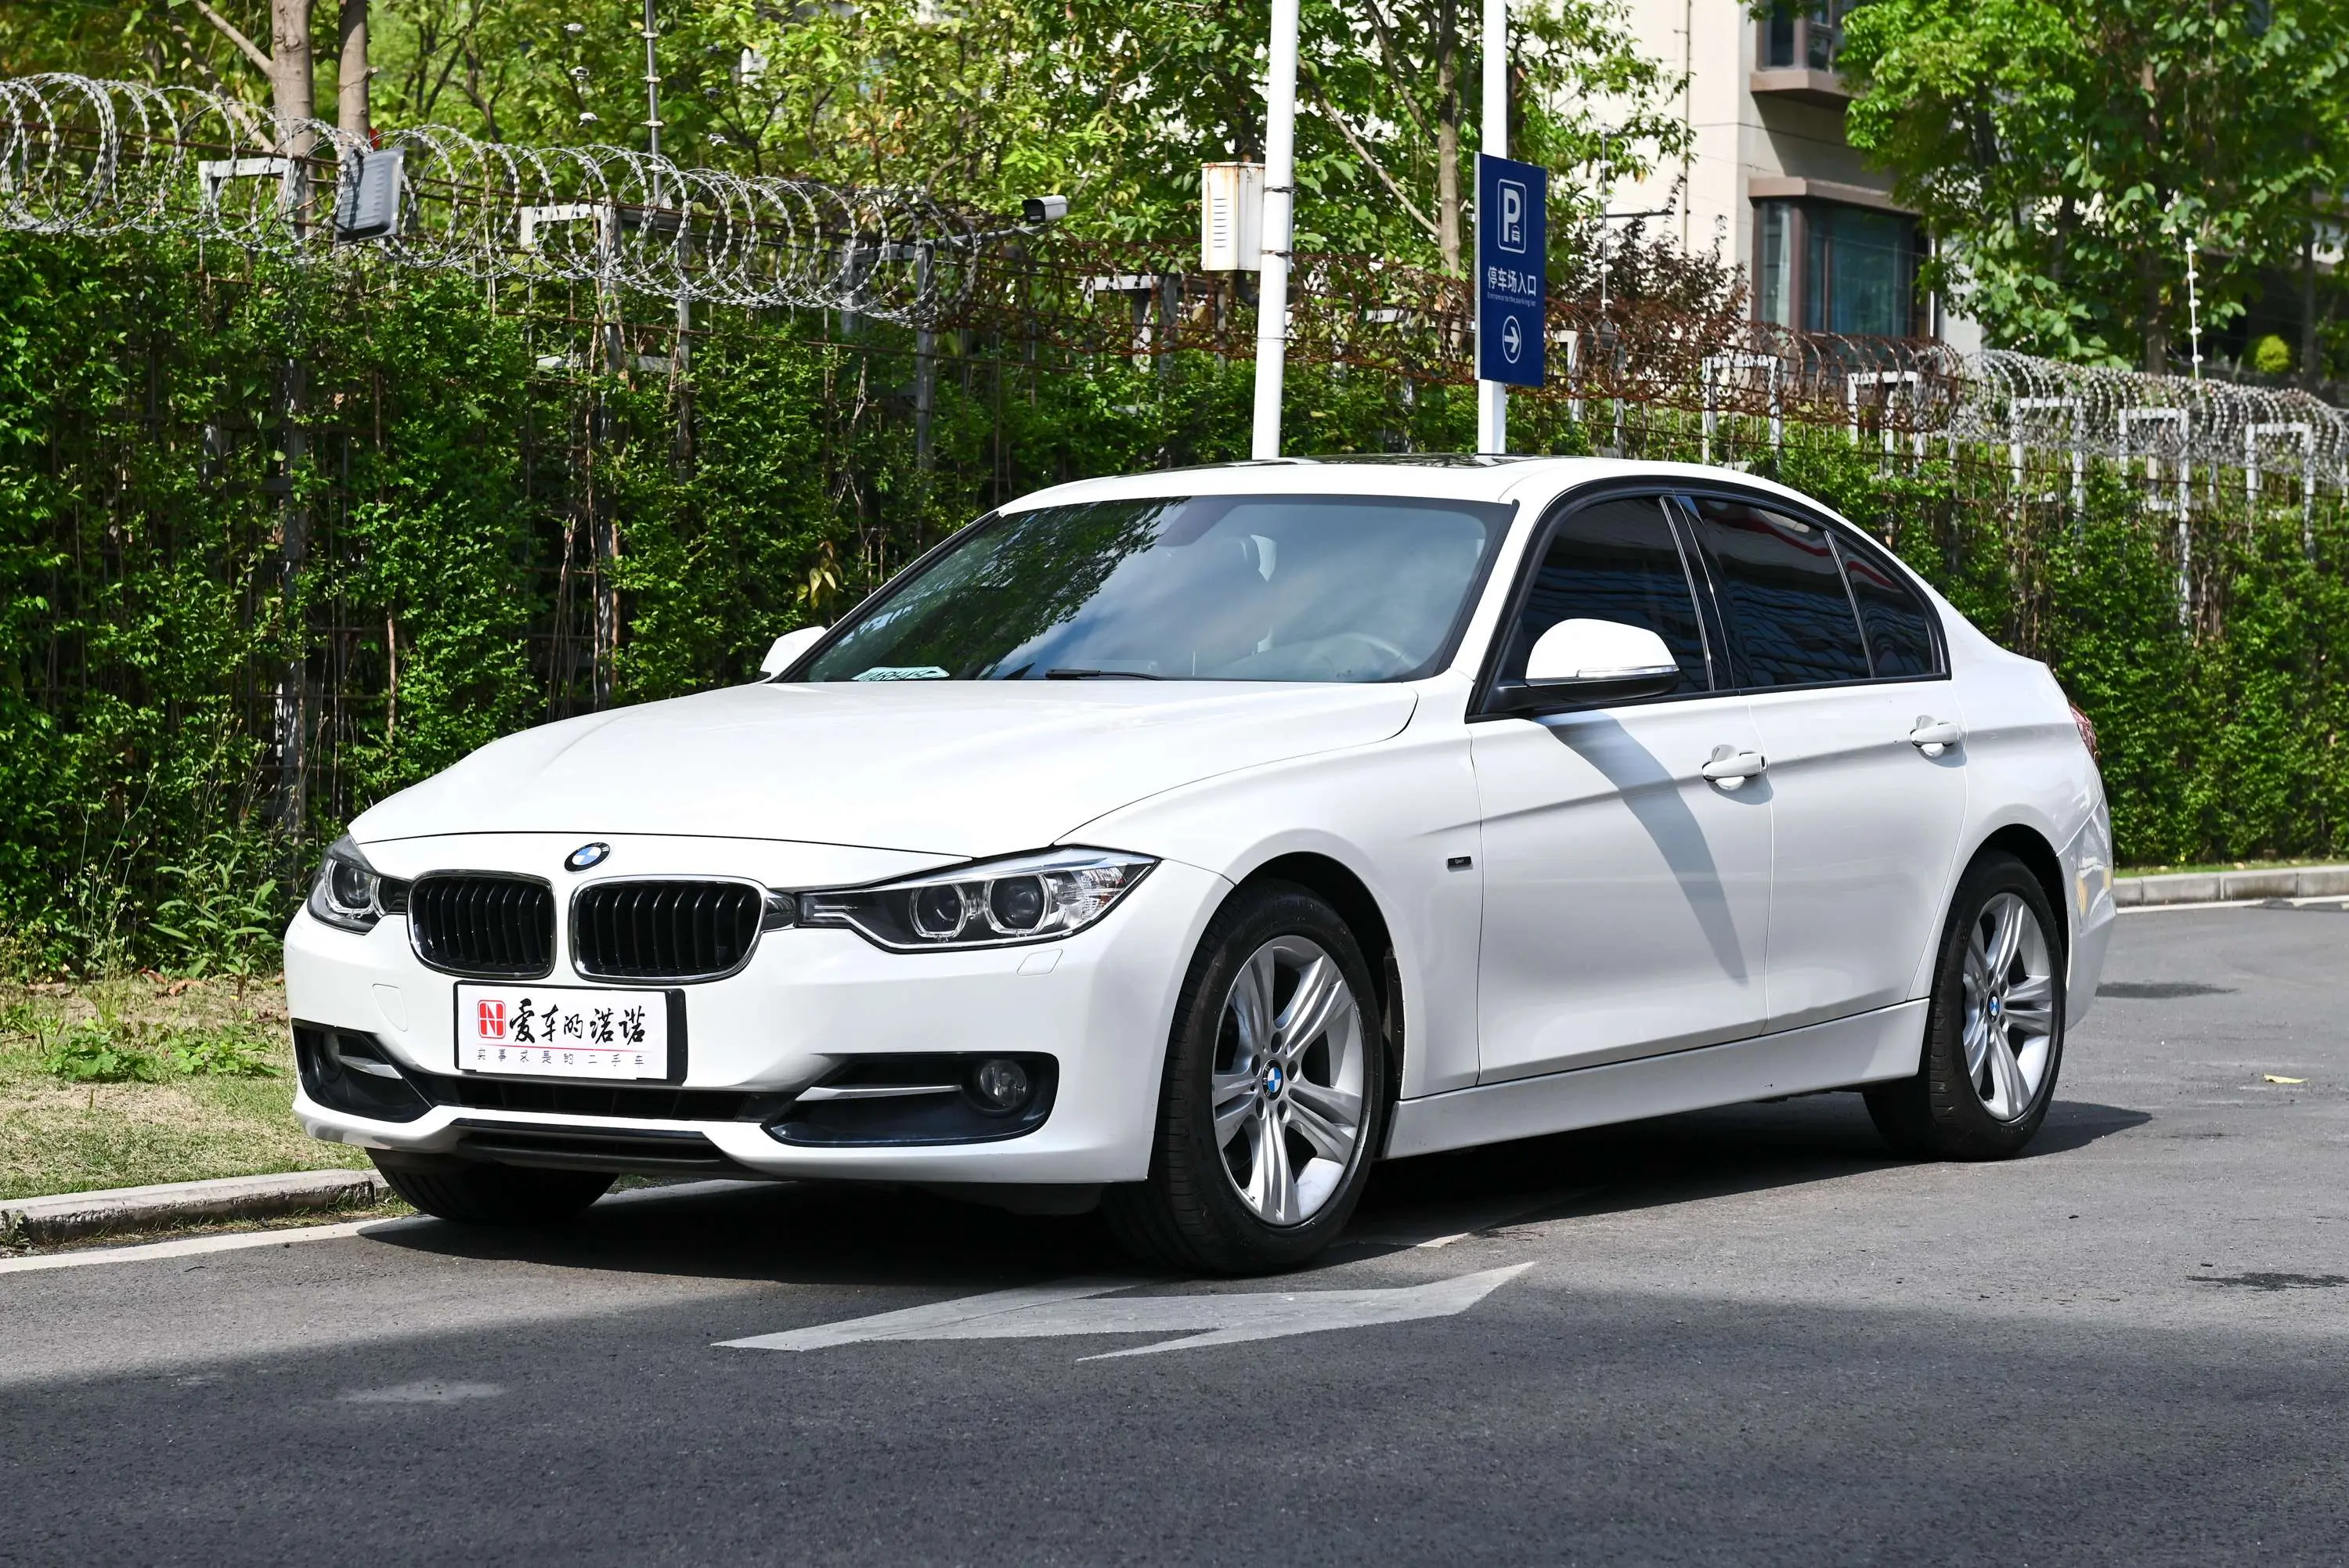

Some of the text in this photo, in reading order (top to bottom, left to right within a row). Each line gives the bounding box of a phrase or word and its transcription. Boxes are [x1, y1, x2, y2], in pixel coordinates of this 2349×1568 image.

[1488, 265, 1536, 296] 停车场入口
[509, 998, 647, 1047] 爱车的诺诺
